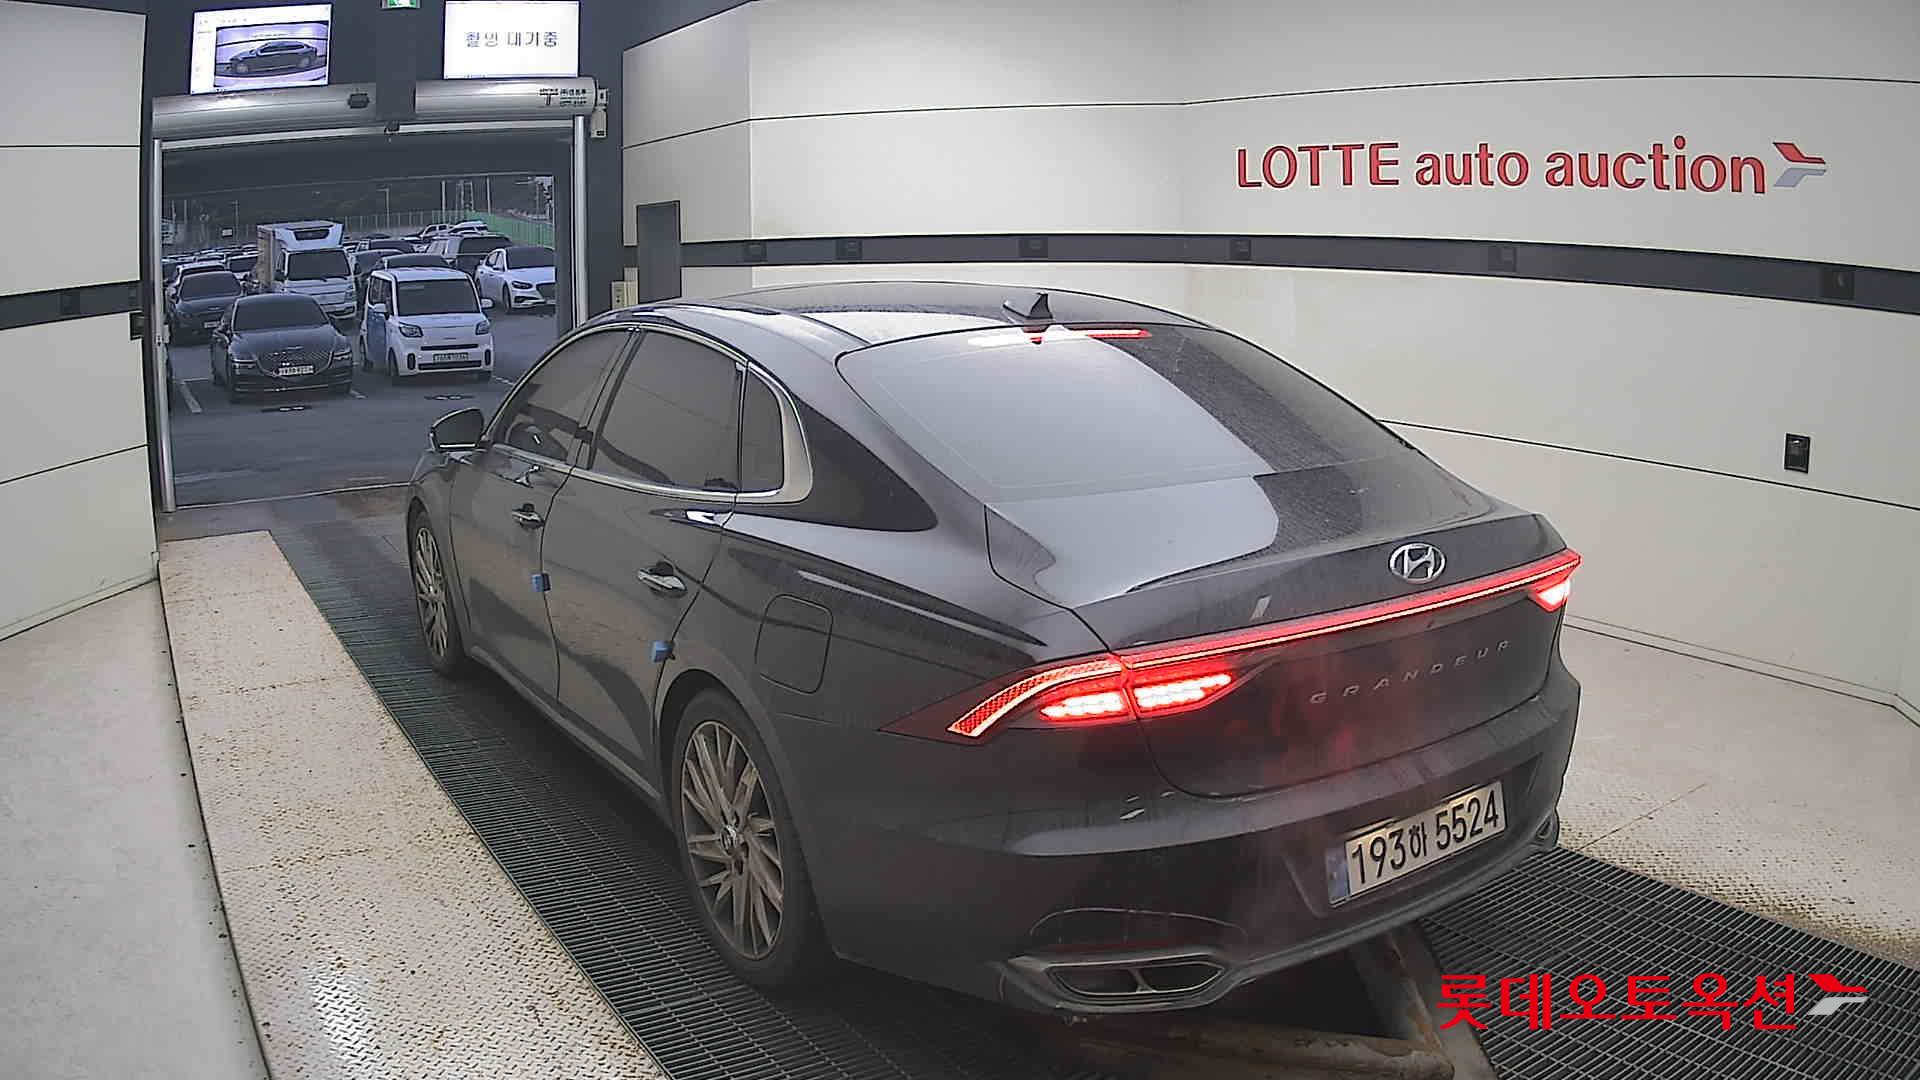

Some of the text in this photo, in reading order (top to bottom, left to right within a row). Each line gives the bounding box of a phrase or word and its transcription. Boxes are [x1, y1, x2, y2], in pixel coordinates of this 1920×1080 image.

[507, 31, 558, 48] 대기중
[1237, 135, 1766, 195] LOTTE auto auction
[1310, 640, 1509, 704] GRANDEUR
[1351, 789, 1500, 885] 193하 5524
